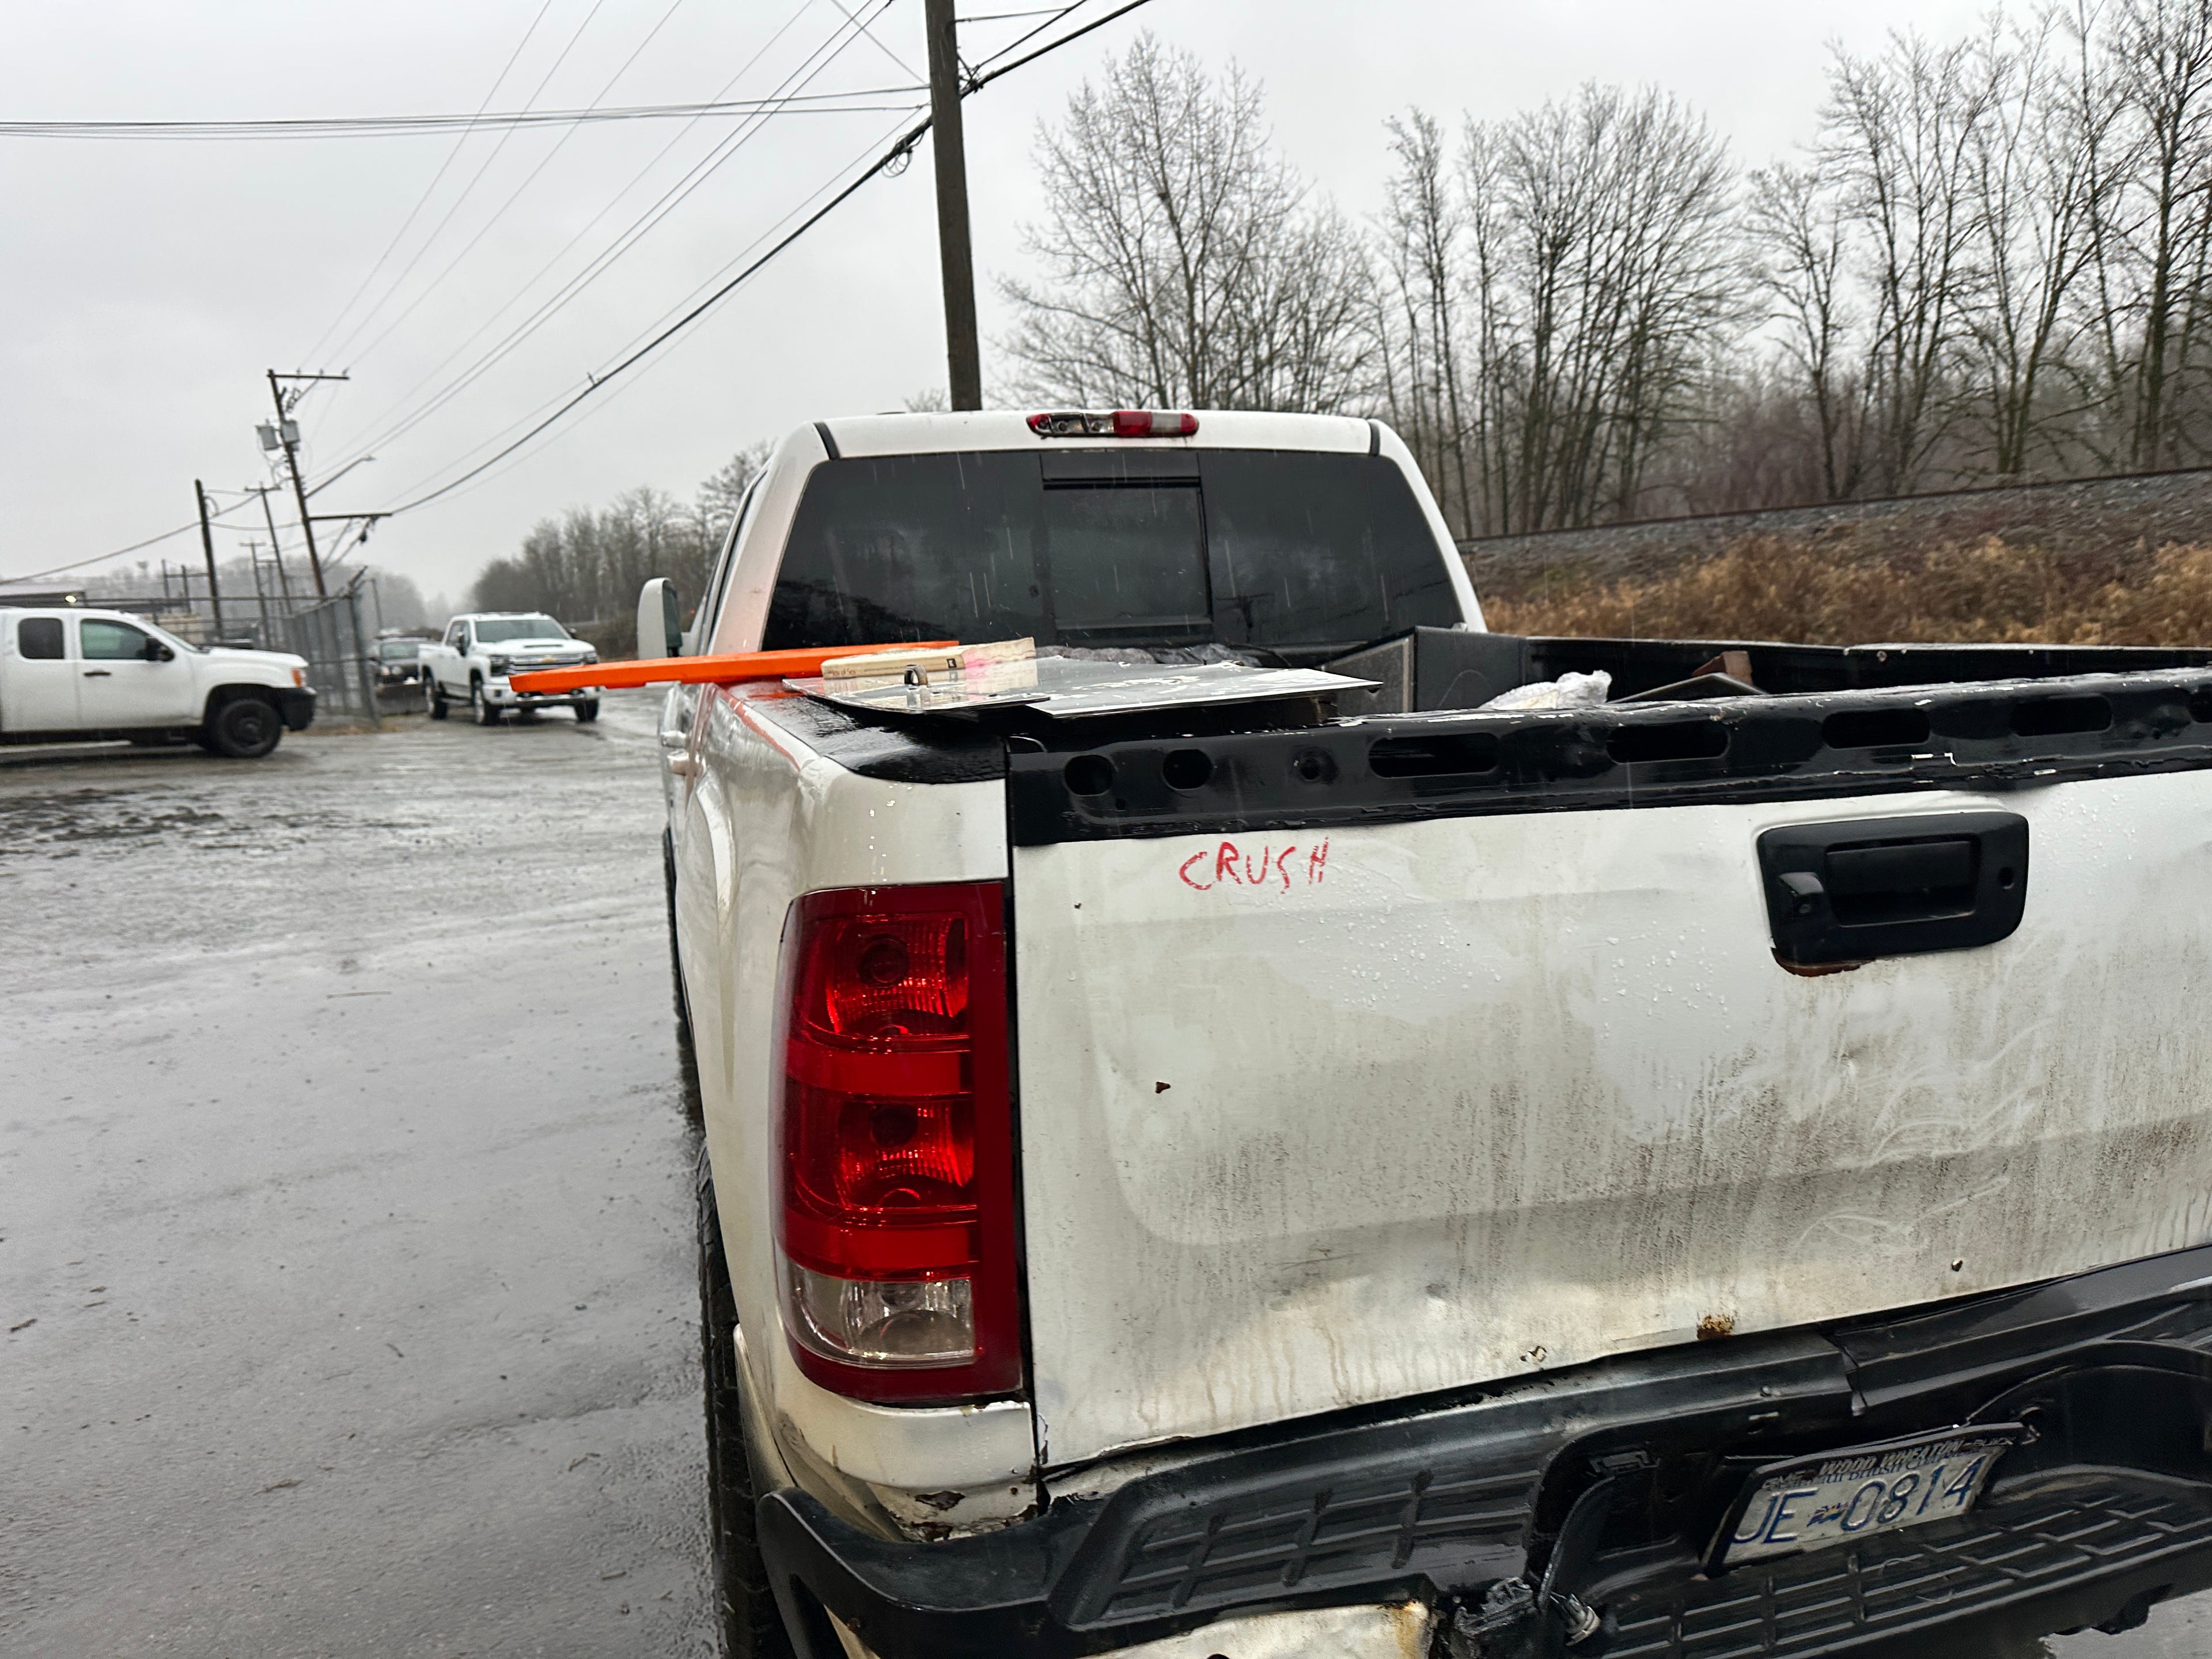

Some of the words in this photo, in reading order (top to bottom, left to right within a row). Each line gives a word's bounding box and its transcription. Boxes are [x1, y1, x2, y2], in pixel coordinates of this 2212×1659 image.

[1179, 836, 1328, 893] CRUSH
[1819, 1456, 1877, 1476] WOOD
[1880, 1438, 1965, 1468] WHEATON
[1841, 1454, 1987, 1532] 0814
